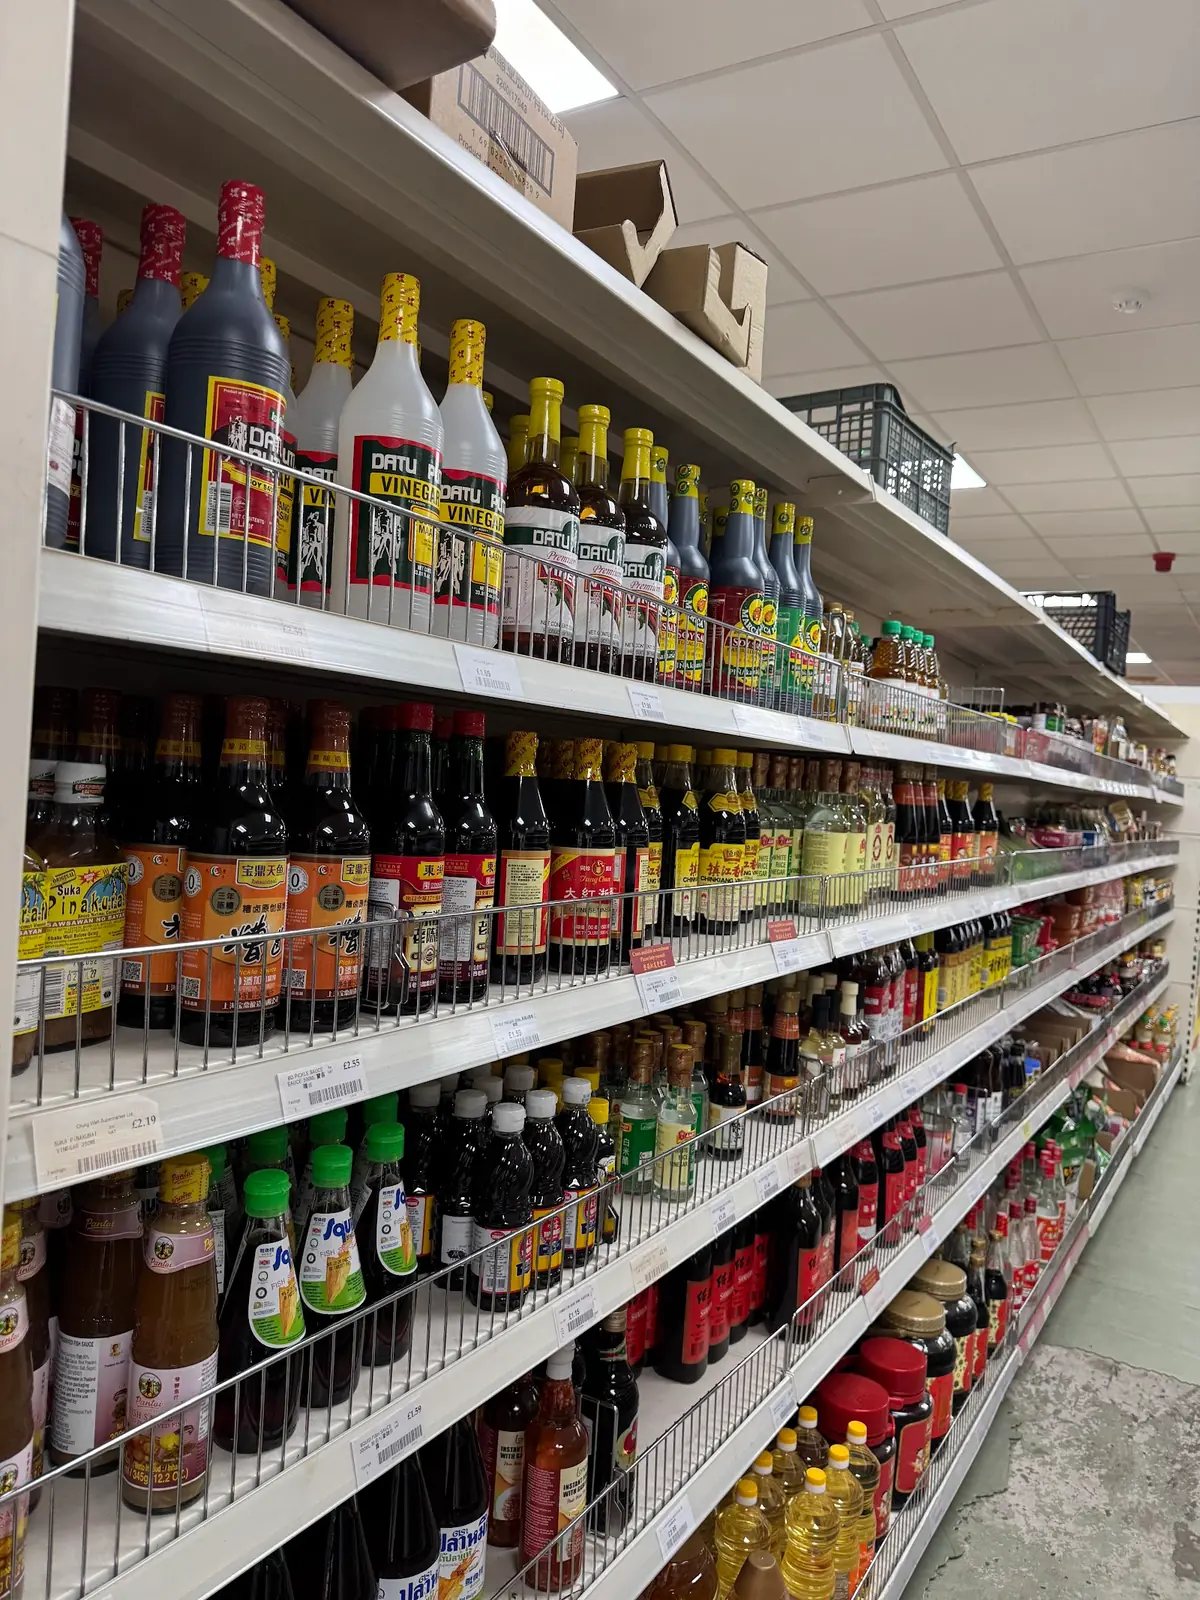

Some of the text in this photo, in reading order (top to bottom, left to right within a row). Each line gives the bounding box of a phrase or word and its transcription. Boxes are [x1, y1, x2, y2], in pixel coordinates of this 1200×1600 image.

[371, 453, 417, 473] DATU
[381, 475, 441, 505] VINEGAR
[441, 484, 481, 504] DATU
[447, 504, 505, 534] VINEGAR
[532, 529, 570, 549] DATU
[547, 551, 577, 565] Premium
[580, 545, 615, 563] DATU
[592, 564, 622, 578] Premium
[630, 580, 662, 593] Premium
[733, 636, 750, 648] SOY
[291, 873, 300, 888] 0
[57, 884, 81, 896] Suka
[294, 1071, 309, 1079] PICKLE
[309, 1066, 324, 1075] SAUCE
[343, 1058, 361, 1071] £2.55
[131, 1114, 157, 1130] £2.19
[86, 1217, 116, 1231] Pantai
[319, 1250, 336, 1258] FISH
[150, 1256, 173, 1269] Pantai
[271, 1278, 286, 1290] FISH
[136, 1395, 163, 1408] Pantai
[407, 1404, 422, 1421] £1.59
[563, 1489, 577, 1498] WITH
